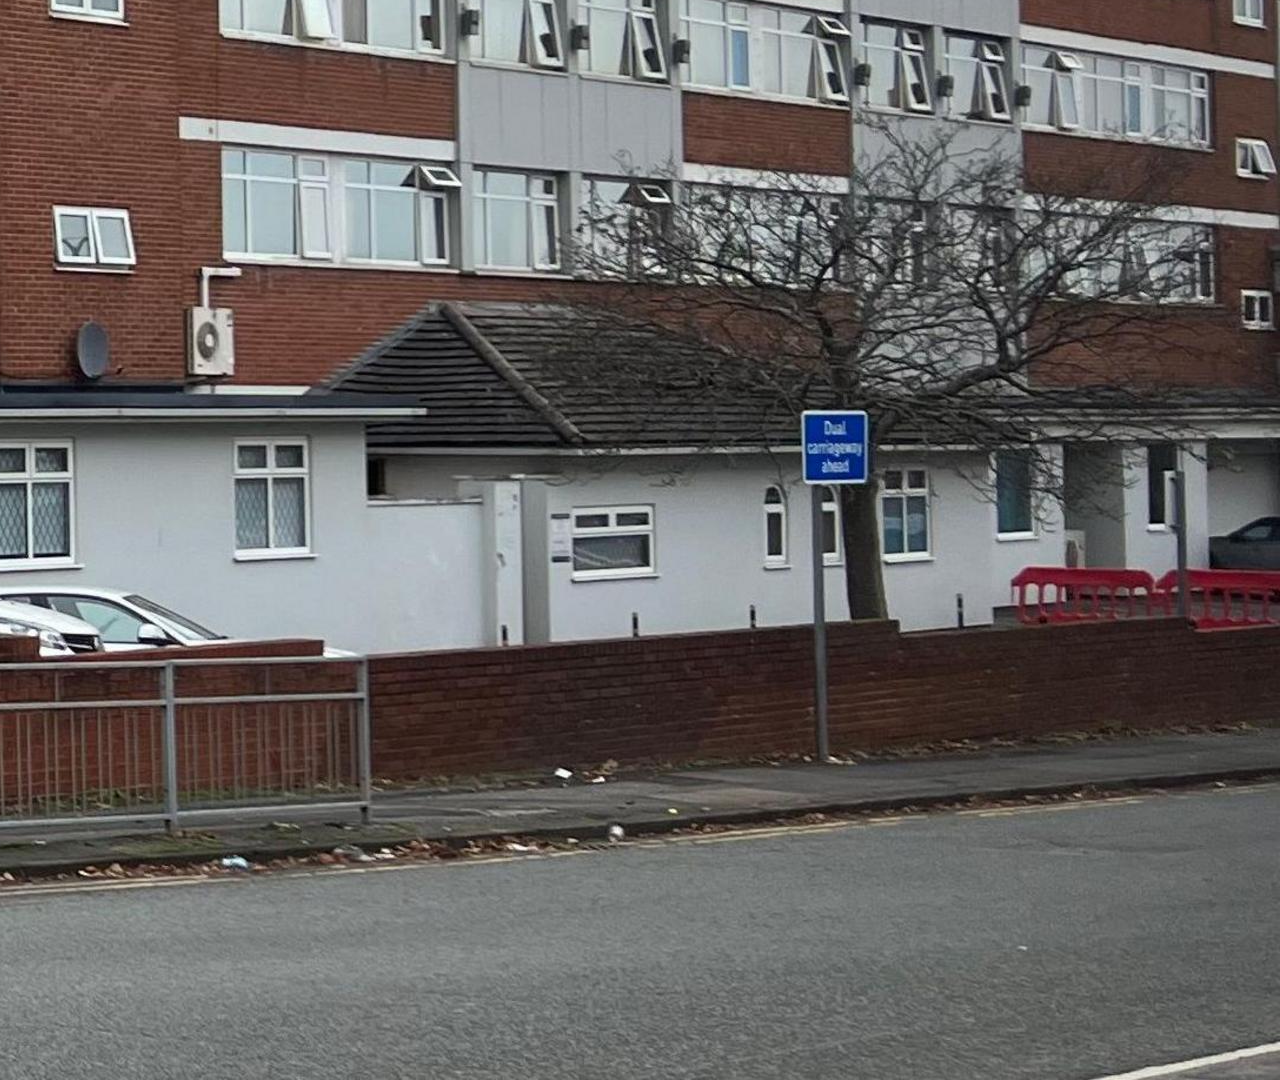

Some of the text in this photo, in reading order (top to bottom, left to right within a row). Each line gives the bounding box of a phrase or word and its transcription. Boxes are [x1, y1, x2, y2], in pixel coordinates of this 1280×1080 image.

[823, 420, 847, 435] Dual
[807, 440, 862, 457] carriageway
[821, 458, 850, 473] ahead
